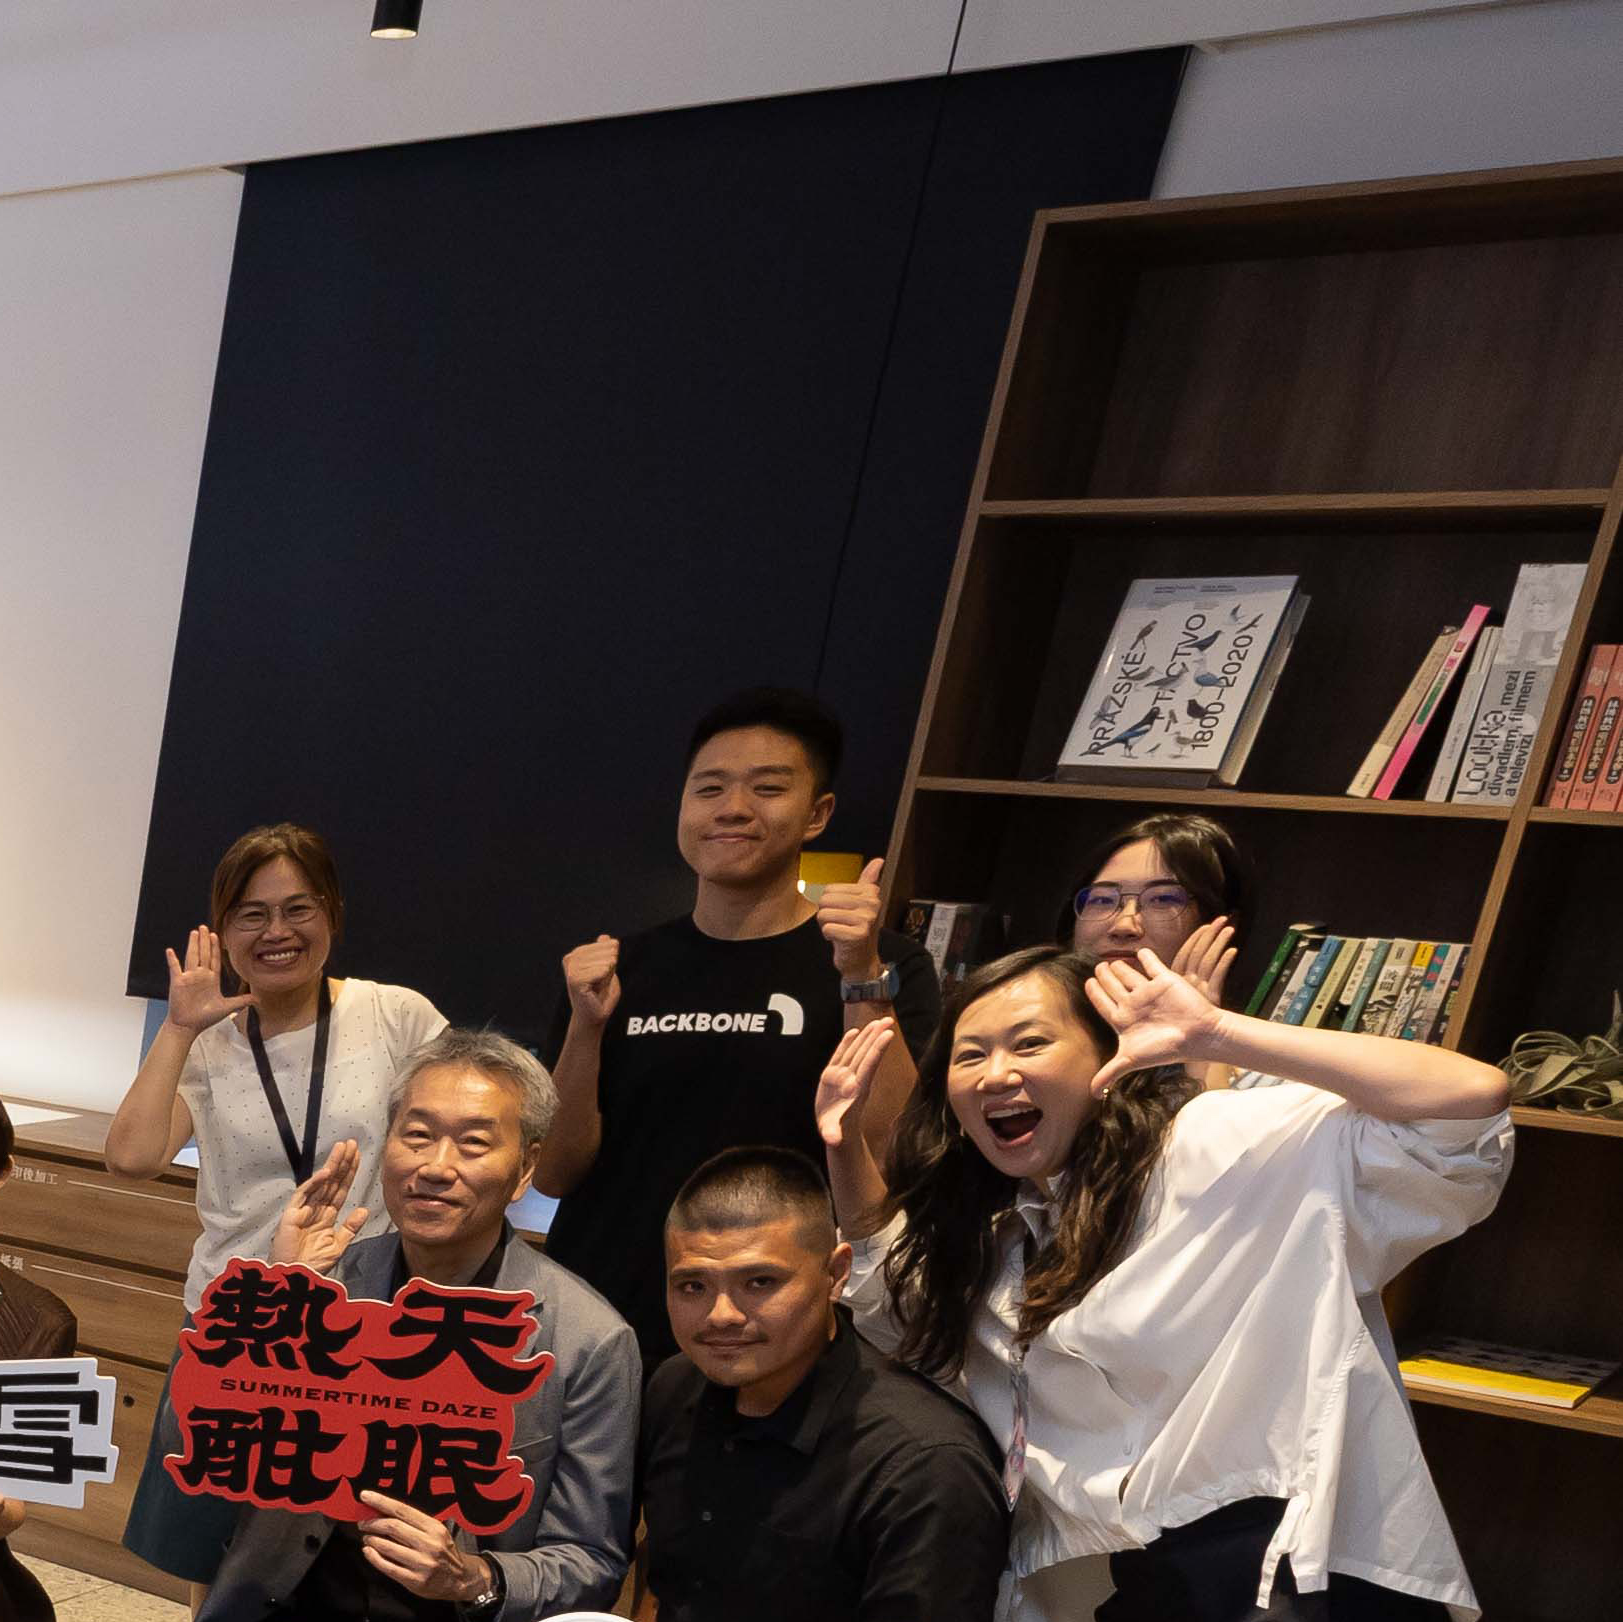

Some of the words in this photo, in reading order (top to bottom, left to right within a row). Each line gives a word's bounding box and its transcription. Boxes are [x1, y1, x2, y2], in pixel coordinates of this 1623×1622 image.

[626, 1012, 768, 1036] BACKBONE
[186, 1267, 551, 1396] 熱天
[219, 1378, 413, 1412] SUMMERTIME
[420, 1400, 498, 1420] DAZE
[178, 1405, 529, 1528] 酣眠
